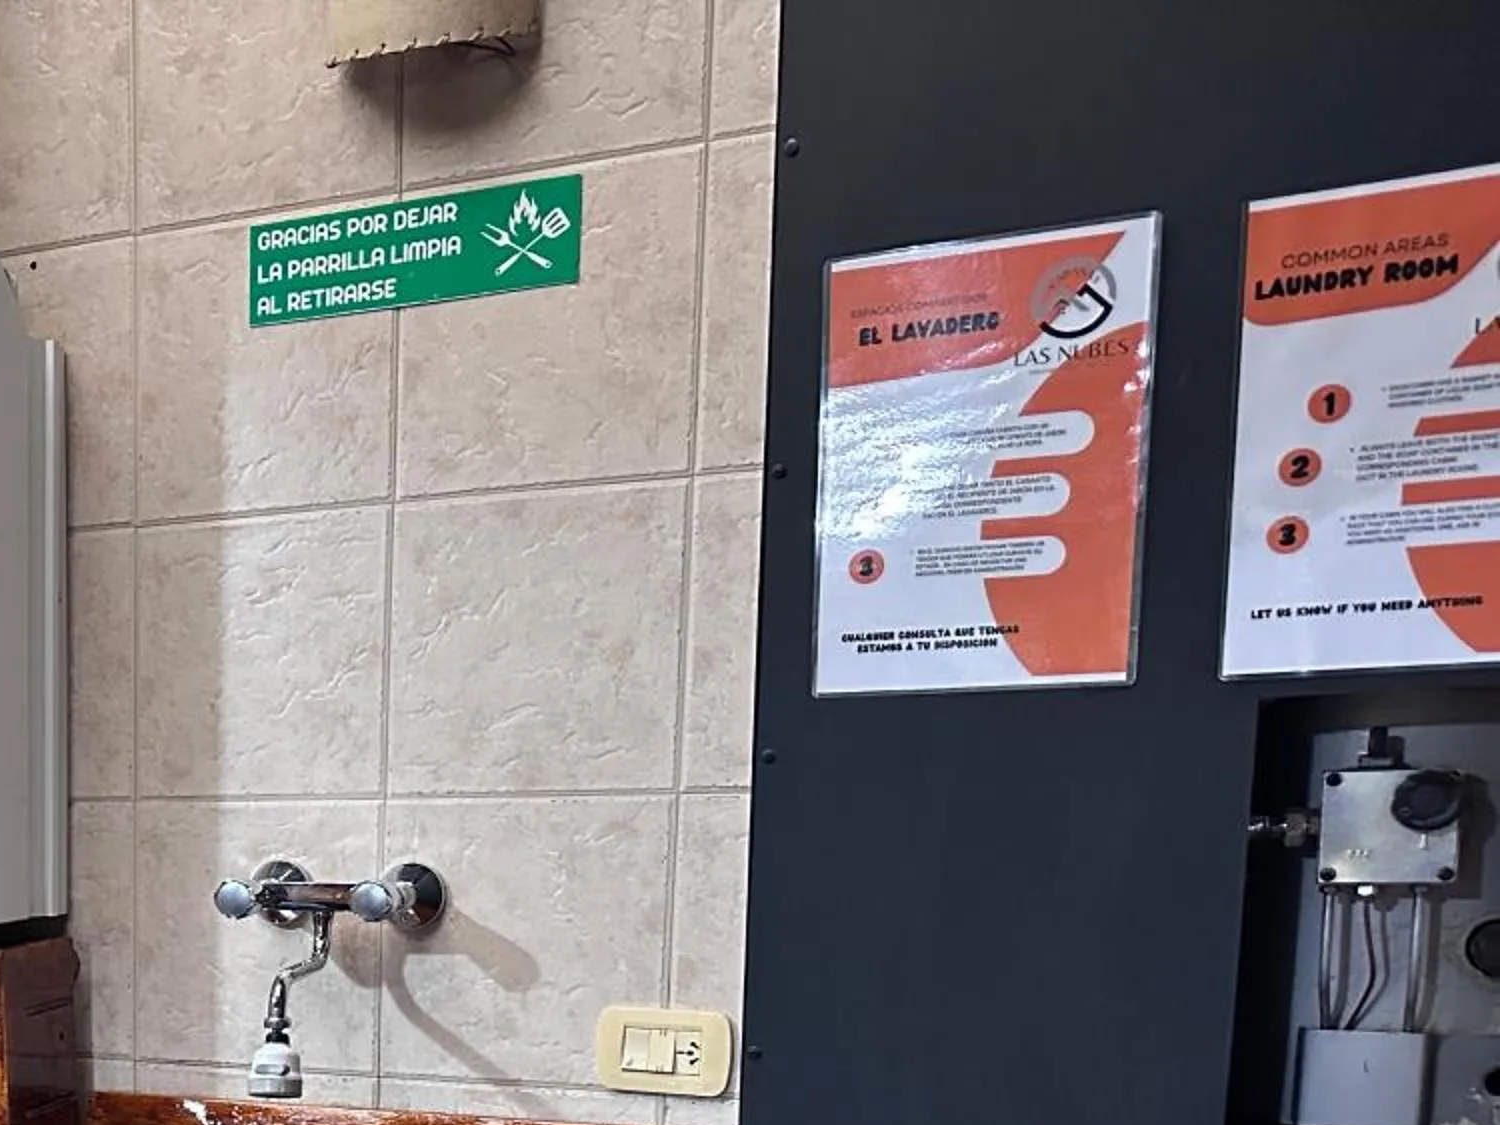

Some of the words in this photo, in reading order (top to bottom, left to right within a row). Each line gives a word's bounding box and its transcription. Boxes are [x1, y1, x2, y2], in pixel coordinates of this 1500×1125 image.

[257, 219, 342, 251] GRACIAS
[347, 213, 388, 236] POR
[393, 201, 459, 231] DEJAR
[257, 262, 283, 285] LA
[288, 247, 385, 280] PARRILLA
[390, 235, 462, 265] LIMPIA
[1281, 243, 1378, 269] COMMON
[1382, 232, 1450, 253] AREAS
[1255, 265, 1374, 301] LAUNDRY
[1384, 254, 1459, 283] ROOM
[257, 296, 283, 317] AL
[287, 278, 398, 313] RETIRARSE
[859, 326, 882, 346] EL
[891, 311, 1000, 343] LAVADERO
[1013, 346, 1051, 367] LAS
[1057, 340, 1130, 362] NUBES
[1323, 391, 1336, 416] 1
[1290, 455, 1311, 479] 2
[1278, 524, 1297, 546] 3
[859, 556, 874, 577] 3
[1251, 608, 1272, 619] LET
[1276, 607, 1292, 618] US
[1296, 604, 1333, 616] KNOW
[1337, 603, 1349, 614] IF
[1352, 602, 1377, 613] YOU
[1381, 600, 1413, 611] NEED
[841, 631, 895, 643] CUALQUIER
[898, 628, 952, 640] CONSULTA
[954, 626, 976, 637] QUE
[857, 642, 903, 654] ESTAMOS
[906, 642, 913, 651] A
[917, 640, 931, 651] TU
